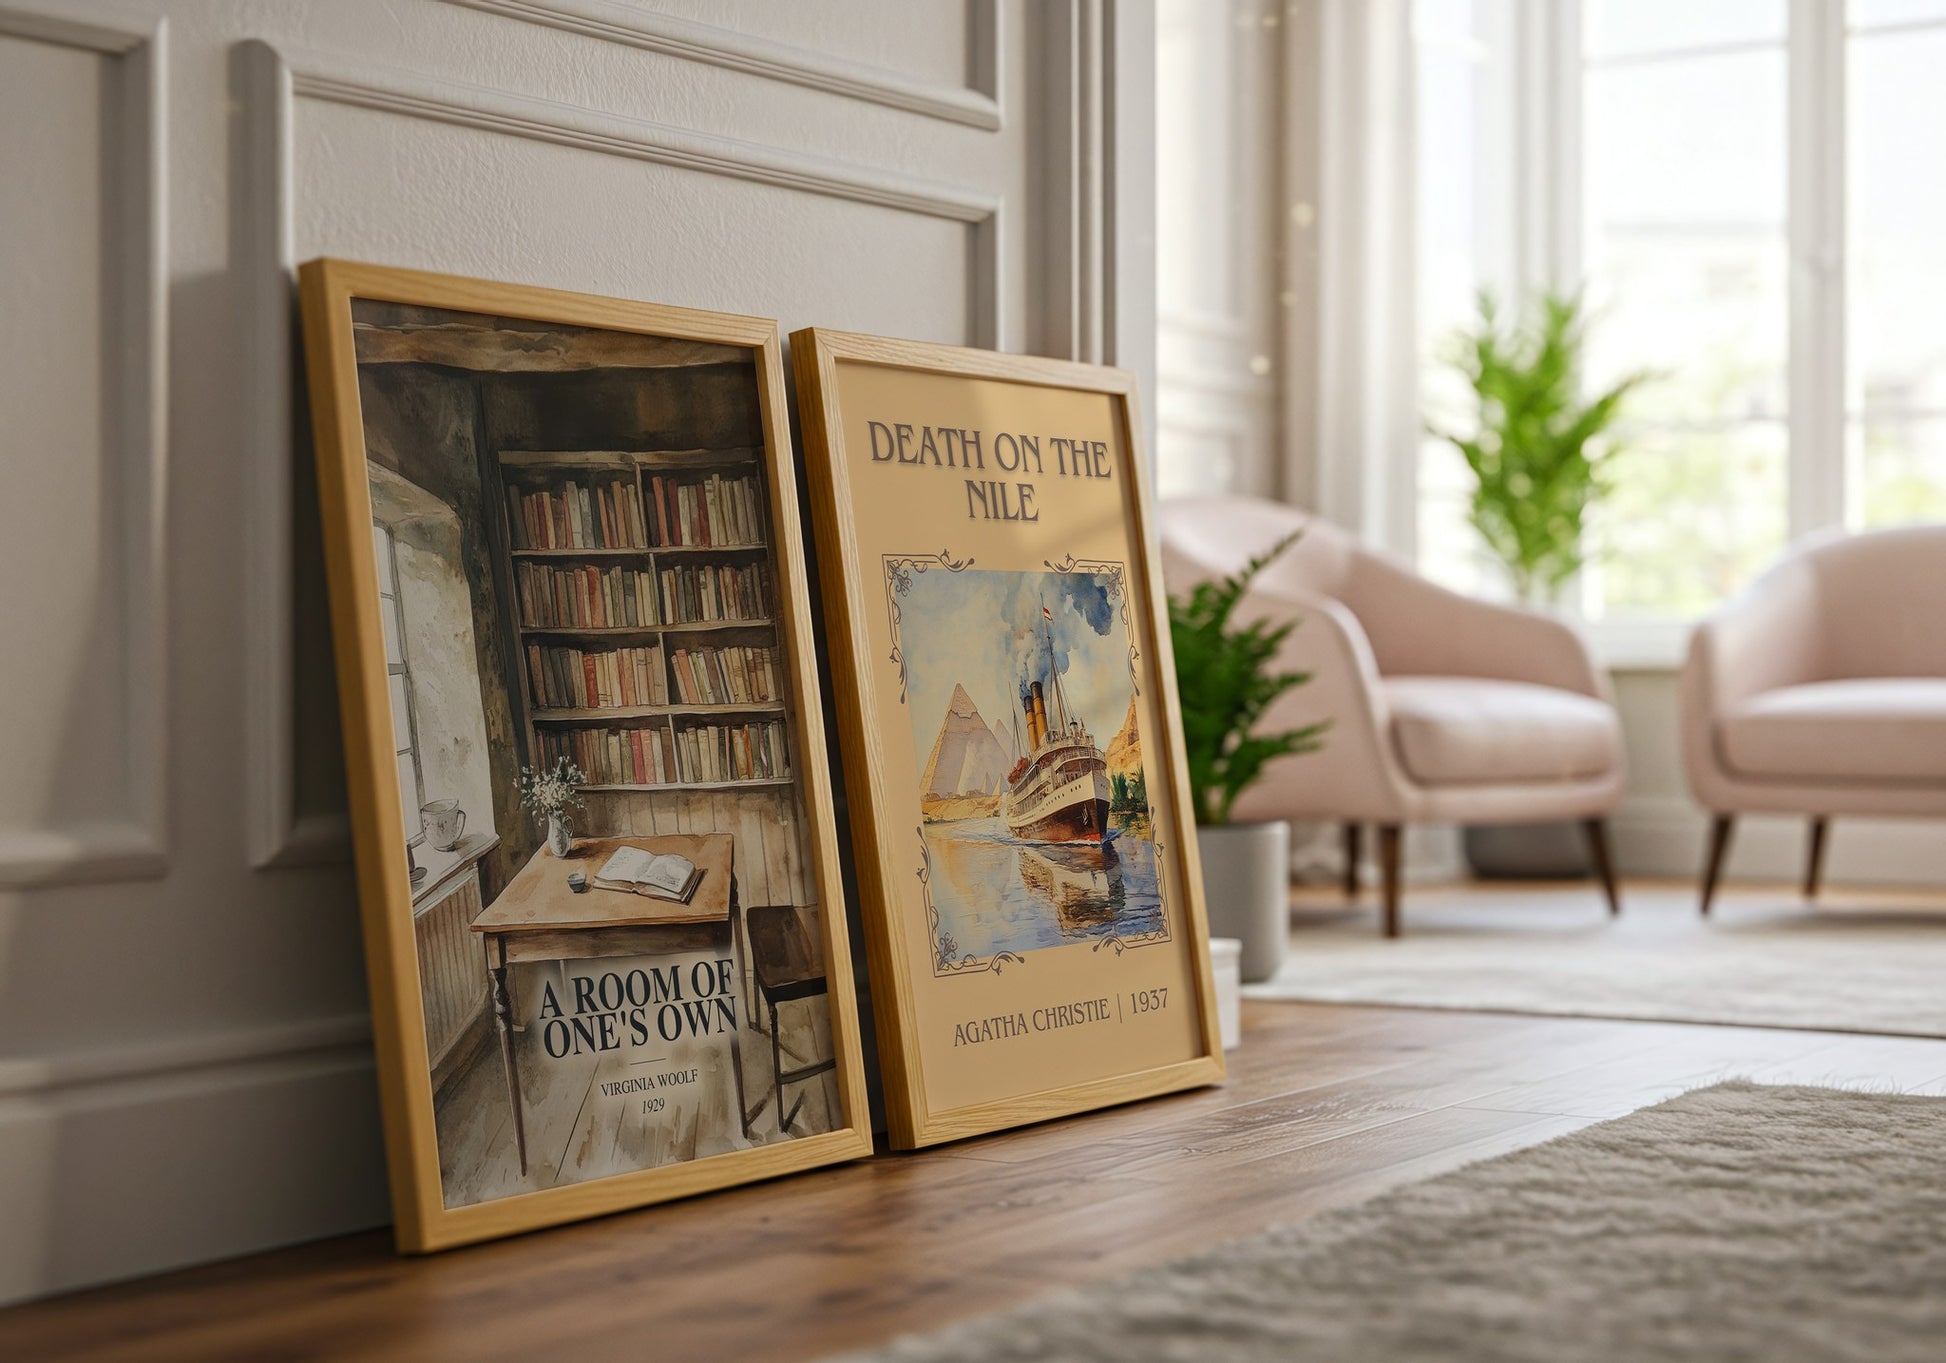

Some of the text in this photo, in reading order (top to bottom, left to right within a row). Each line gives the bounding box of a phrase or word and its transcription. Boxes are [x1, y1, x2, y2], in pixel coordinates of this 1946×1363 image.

[868, 421, 1112, 478] DEATH ON THE
[965, 480, 1039, 521] NILE
[539, 958, 734, 1019] A ROOM OF
[543, 996, 738, 1058] ONE'S OWN
[954, 1013, 1029, 1047] AGATHA
[1032, 998, 1111, 1031] CHRISTIE
[1130, 988, 1168, 1014] 1937
[601, 1069, 698, 1097] VIRGINIA WOOLF
[642, 1098, 665, 1114] 1929
